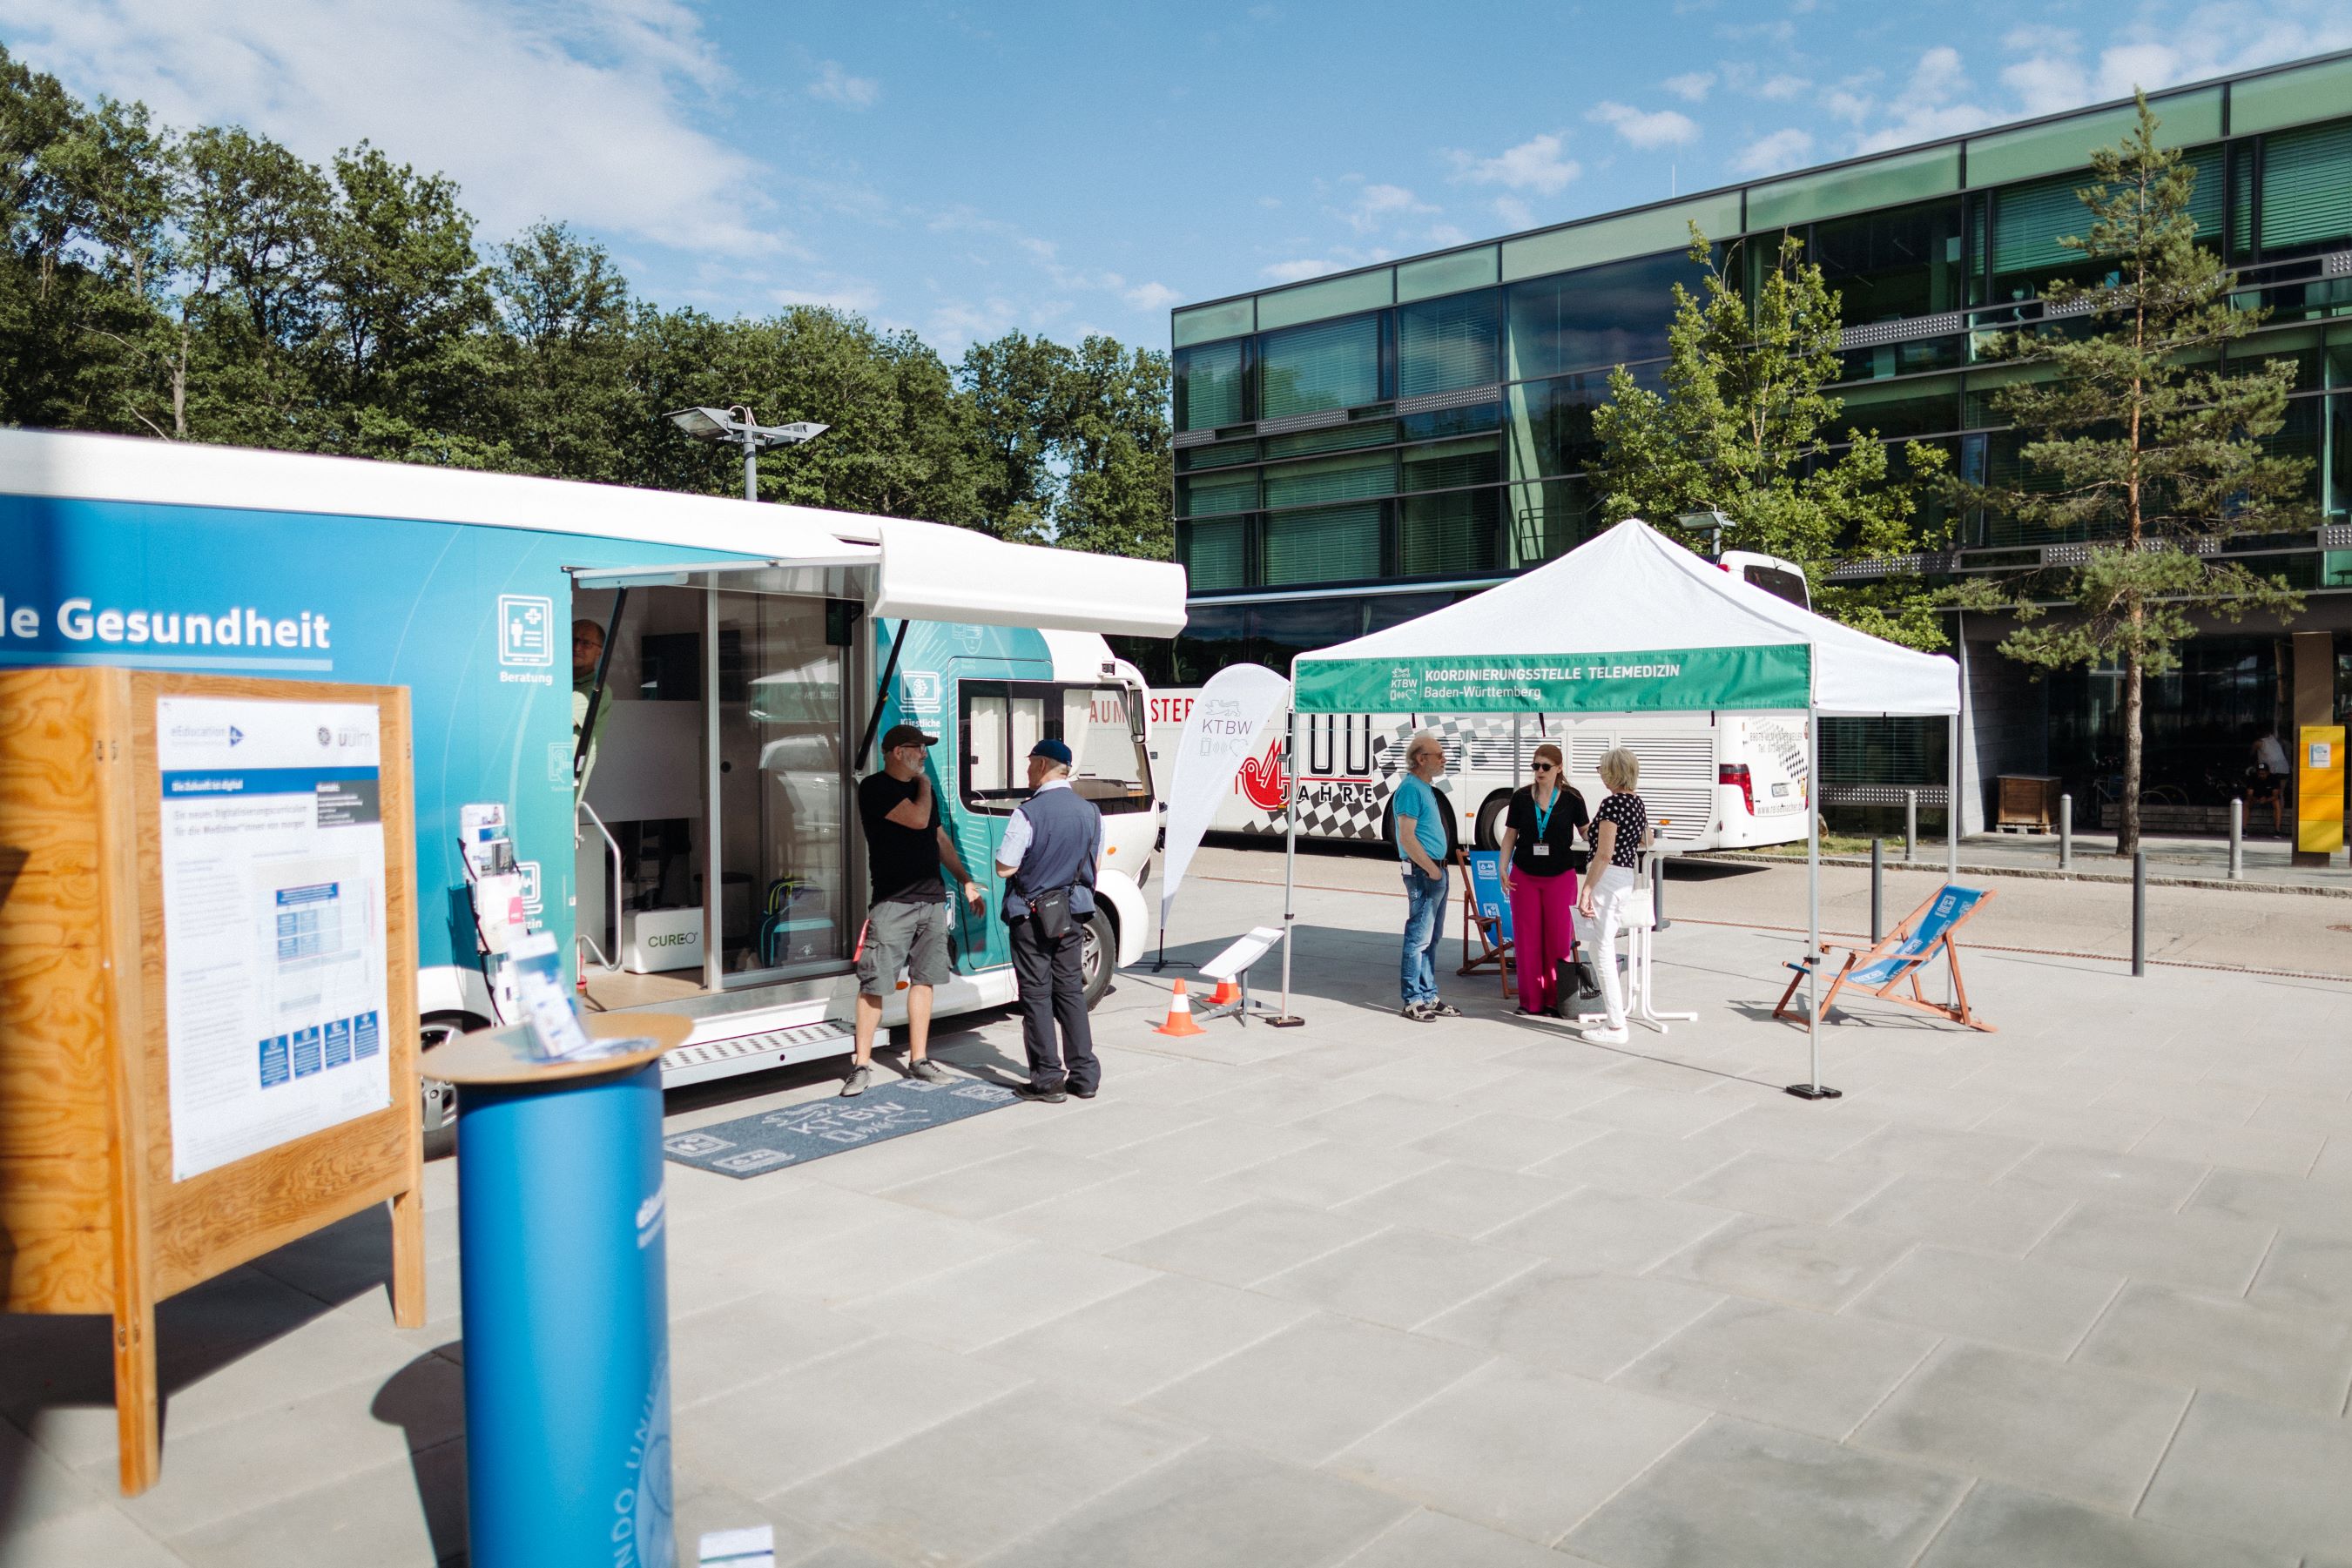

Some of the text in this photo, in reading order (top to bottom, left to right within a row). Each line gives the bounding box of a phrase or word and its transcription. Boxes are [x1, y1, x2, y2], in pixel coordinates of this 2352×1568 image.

[57, 596, 331, 649] Gesundheit
[500, 671, 553, 686] Beratung
[1425, 664, 1681, 682] KOORDINIERUNGSSTELLE TELEMEDIZIN
[1392, 679, 1418, 688] KTBW
[1424, 686, 1541, 700] Baden-Württemberg
[900, 718, 941, 729] Künstliche
[1202, 719, 1253, 735] KTBW
[1280, 784, 1373, 804] JAHRE
[787, 1101, 906, 1134] KTBW
